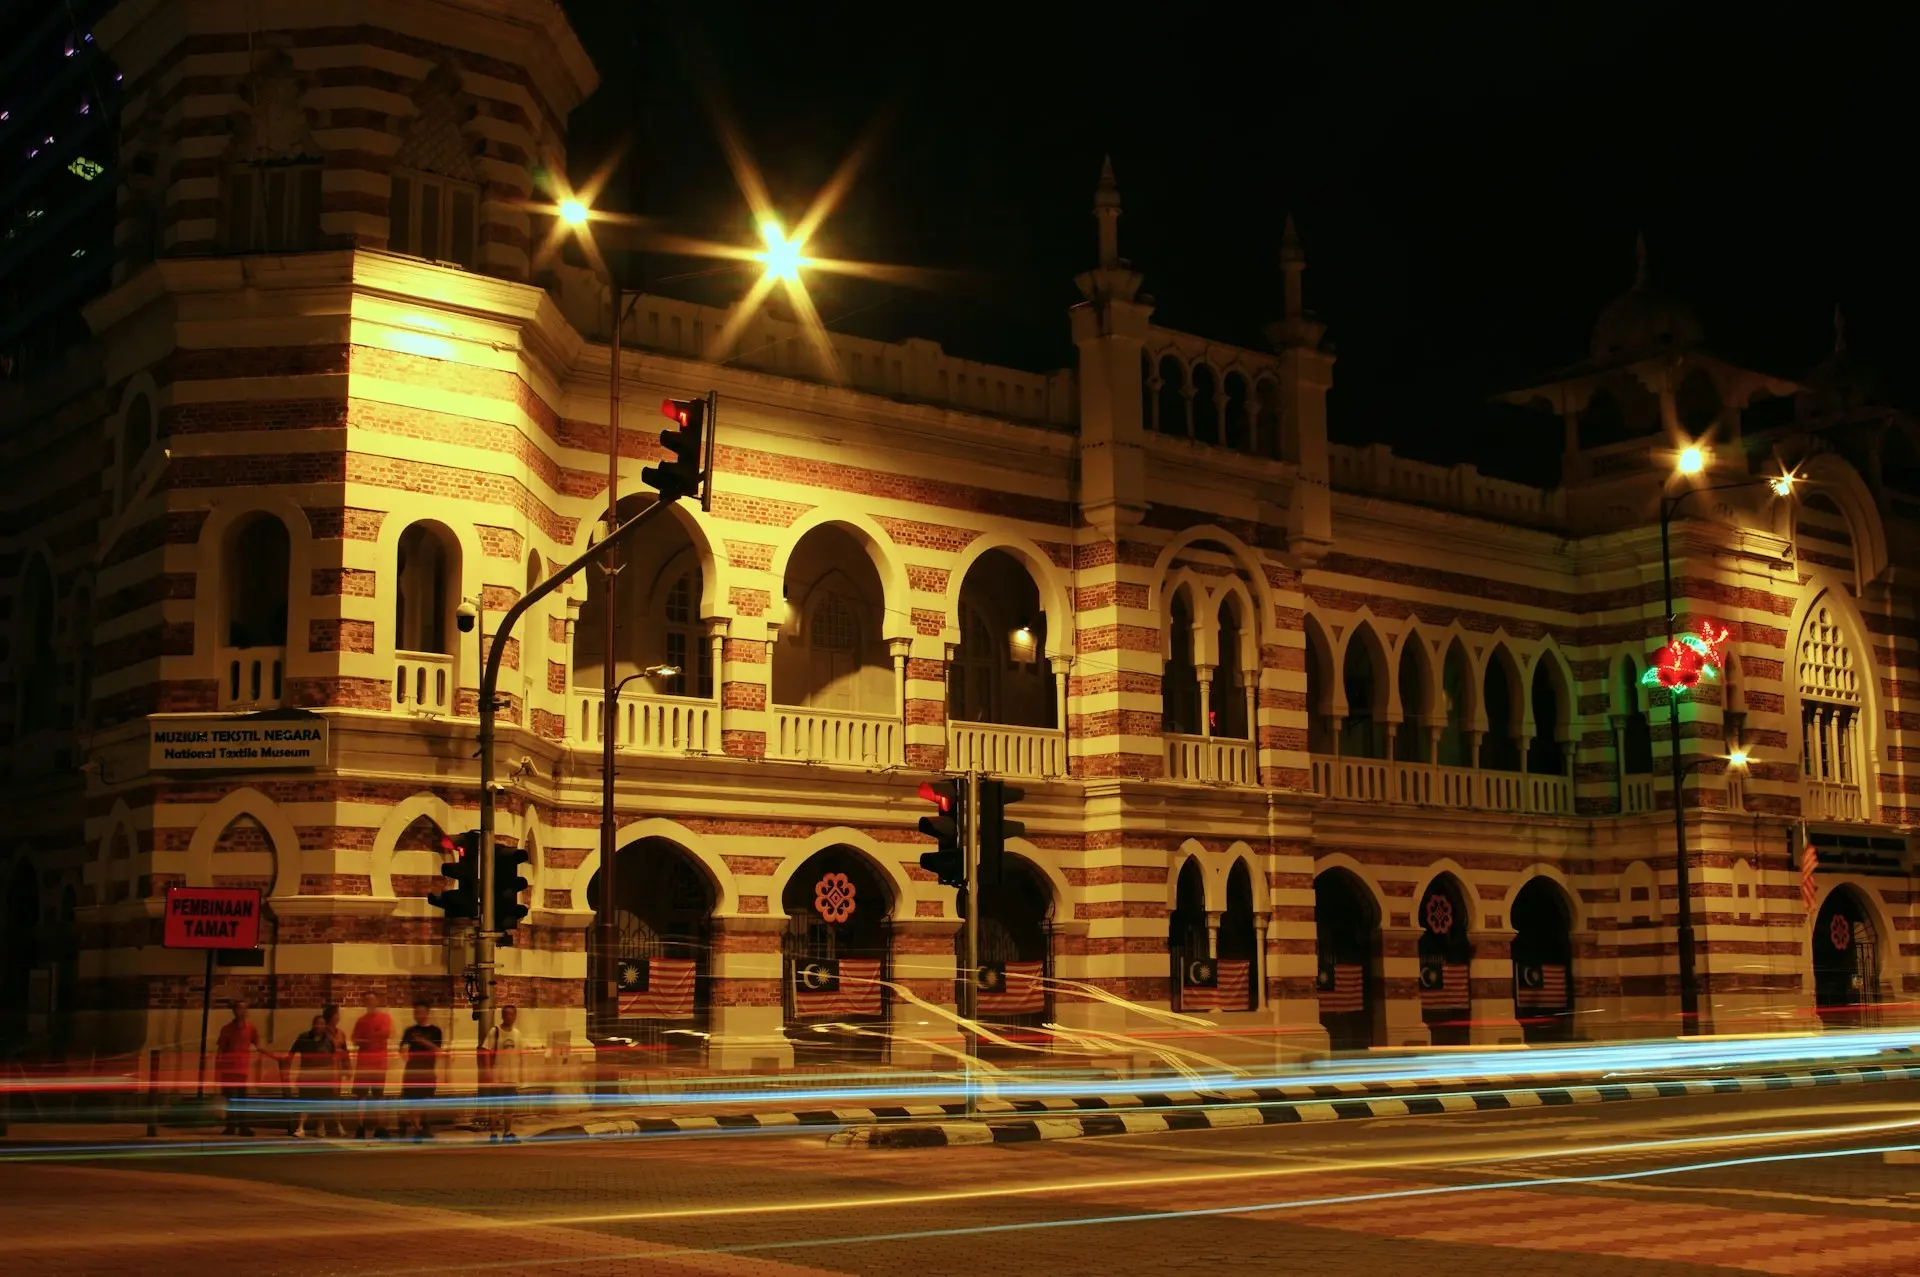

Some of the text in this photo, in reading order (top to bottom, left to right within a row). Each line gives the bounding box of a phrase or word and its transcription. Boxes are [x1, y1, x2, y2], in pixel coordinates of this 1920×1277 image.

[154, 729, 321, 743] MUZIUM TEKSTIL NEGARA
[164, 747, 310, 760] National Textile Museum
[172, 899, 253, 917] PEMBINAAN
[184, 920, 239, 938] TAMAT
